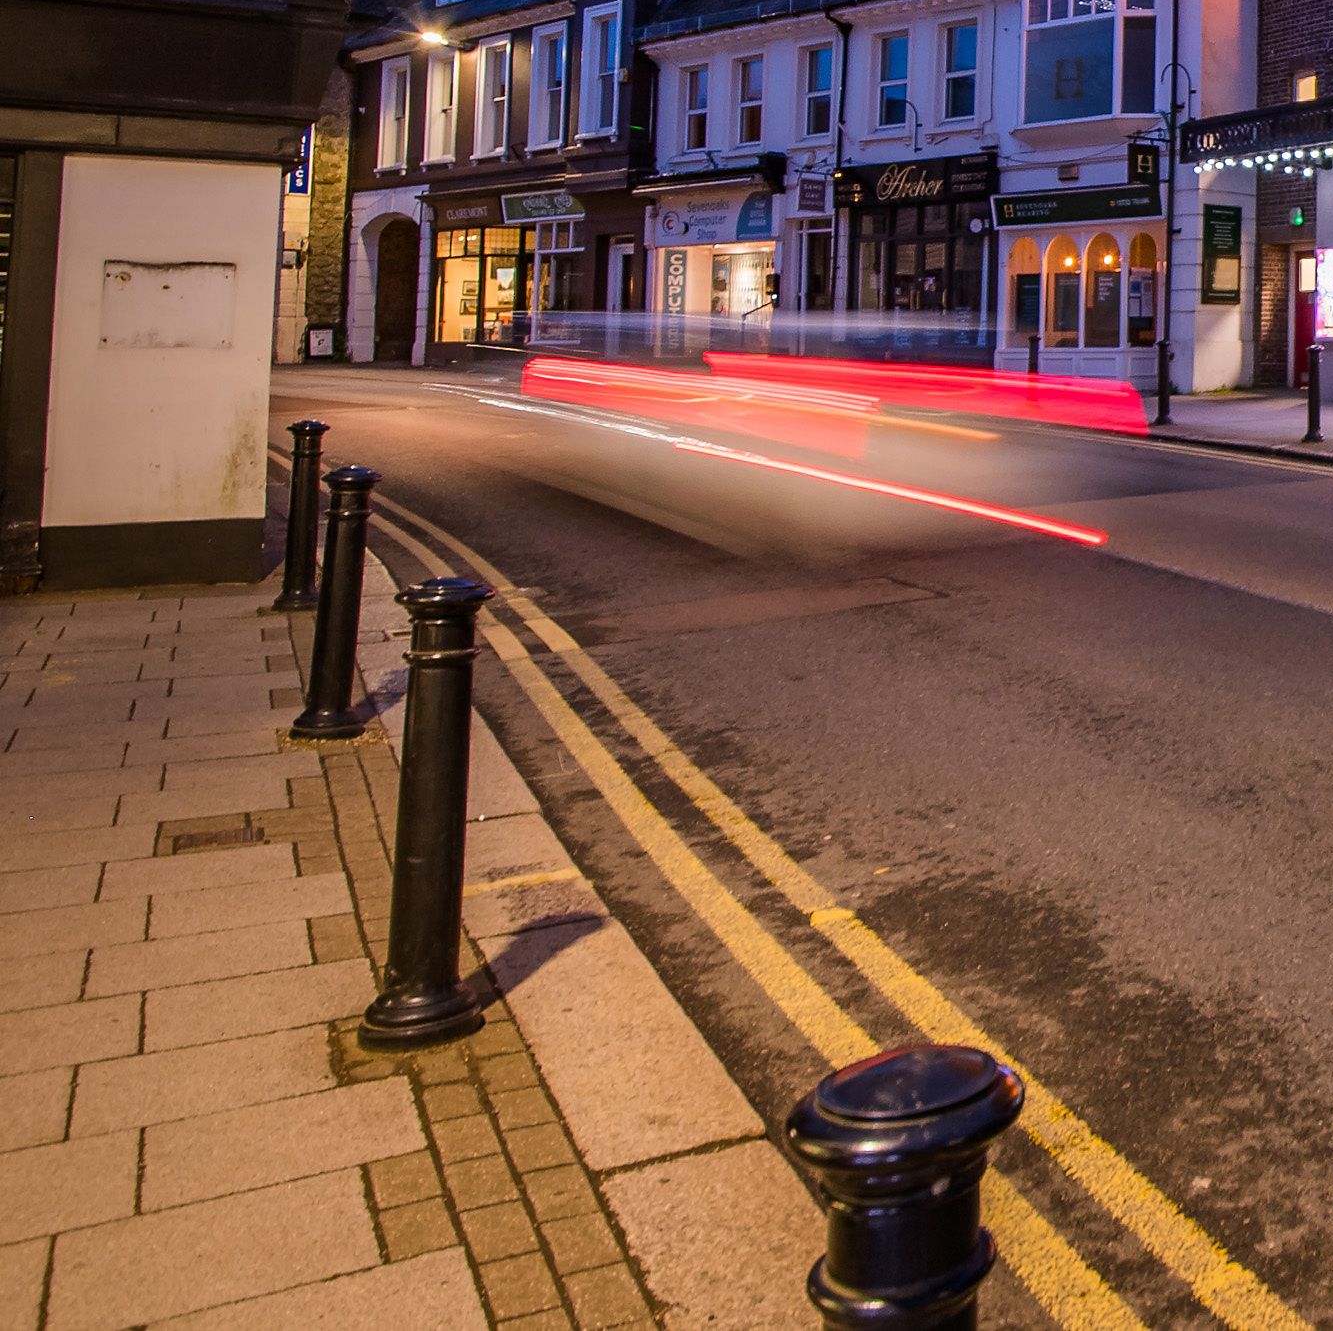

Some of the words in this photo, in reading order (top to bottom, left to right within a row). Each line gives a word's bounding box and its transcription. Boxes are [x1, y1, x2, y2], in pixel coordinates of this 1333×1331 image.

[1137, 154, 1153, 174] H
[876, 164, 944, 201] Archer
[446, 206, 488, 220] CLAREMONT
[688, 215, 727, 228] Computer
[696, 229, 718, 240] Shop
